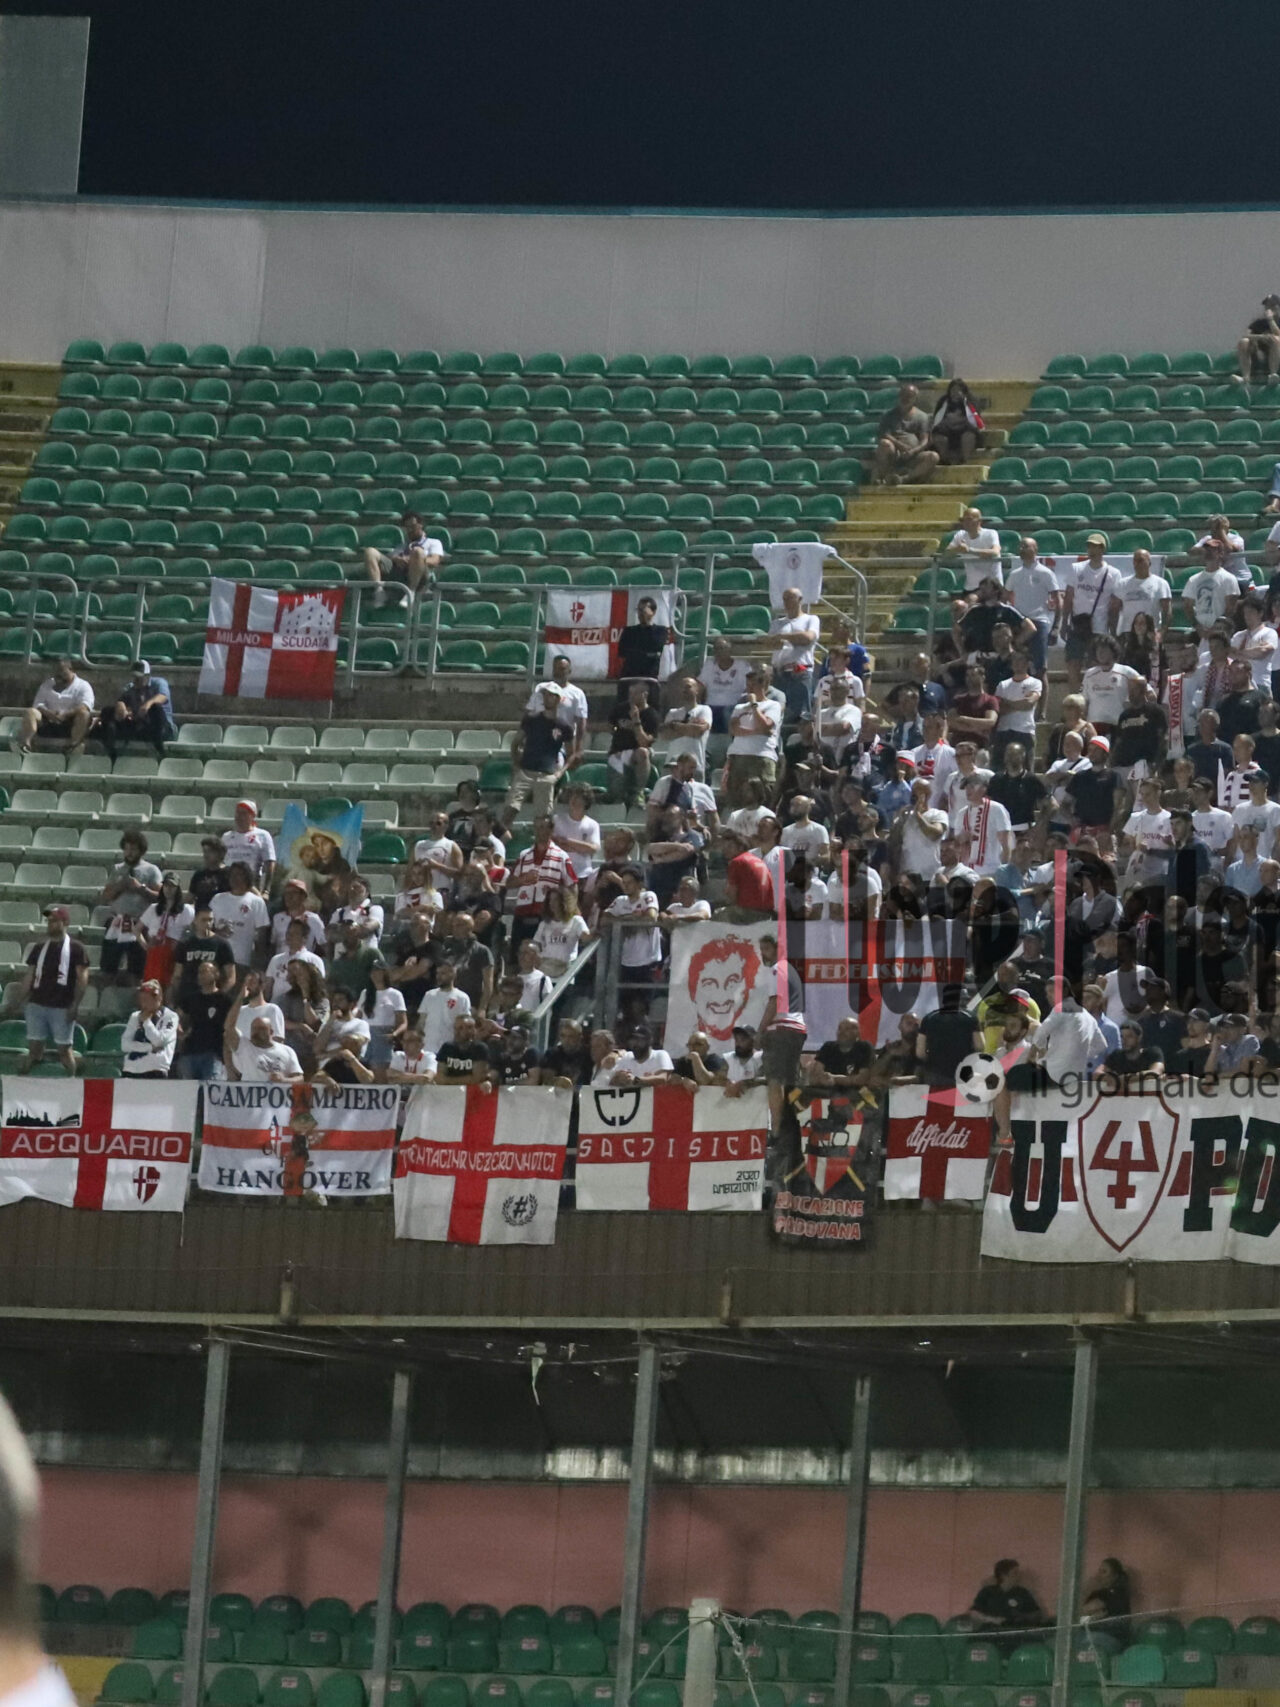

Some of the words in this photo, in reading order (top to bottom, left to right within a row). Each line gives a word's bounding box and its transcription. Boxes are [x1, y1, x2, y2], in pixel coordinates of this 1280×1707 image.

[216, 630, 261, 645] MILANO
[281, 635, 330, 648] SCUDATA
[1169, 678, 1181, 729] PADOVA
[807, 962, 934, 979] FEDELISSIMI
[11, 1133, 183, 1157] ACQUARIO
[217, 1166, 372, 1190] HANGOVER
